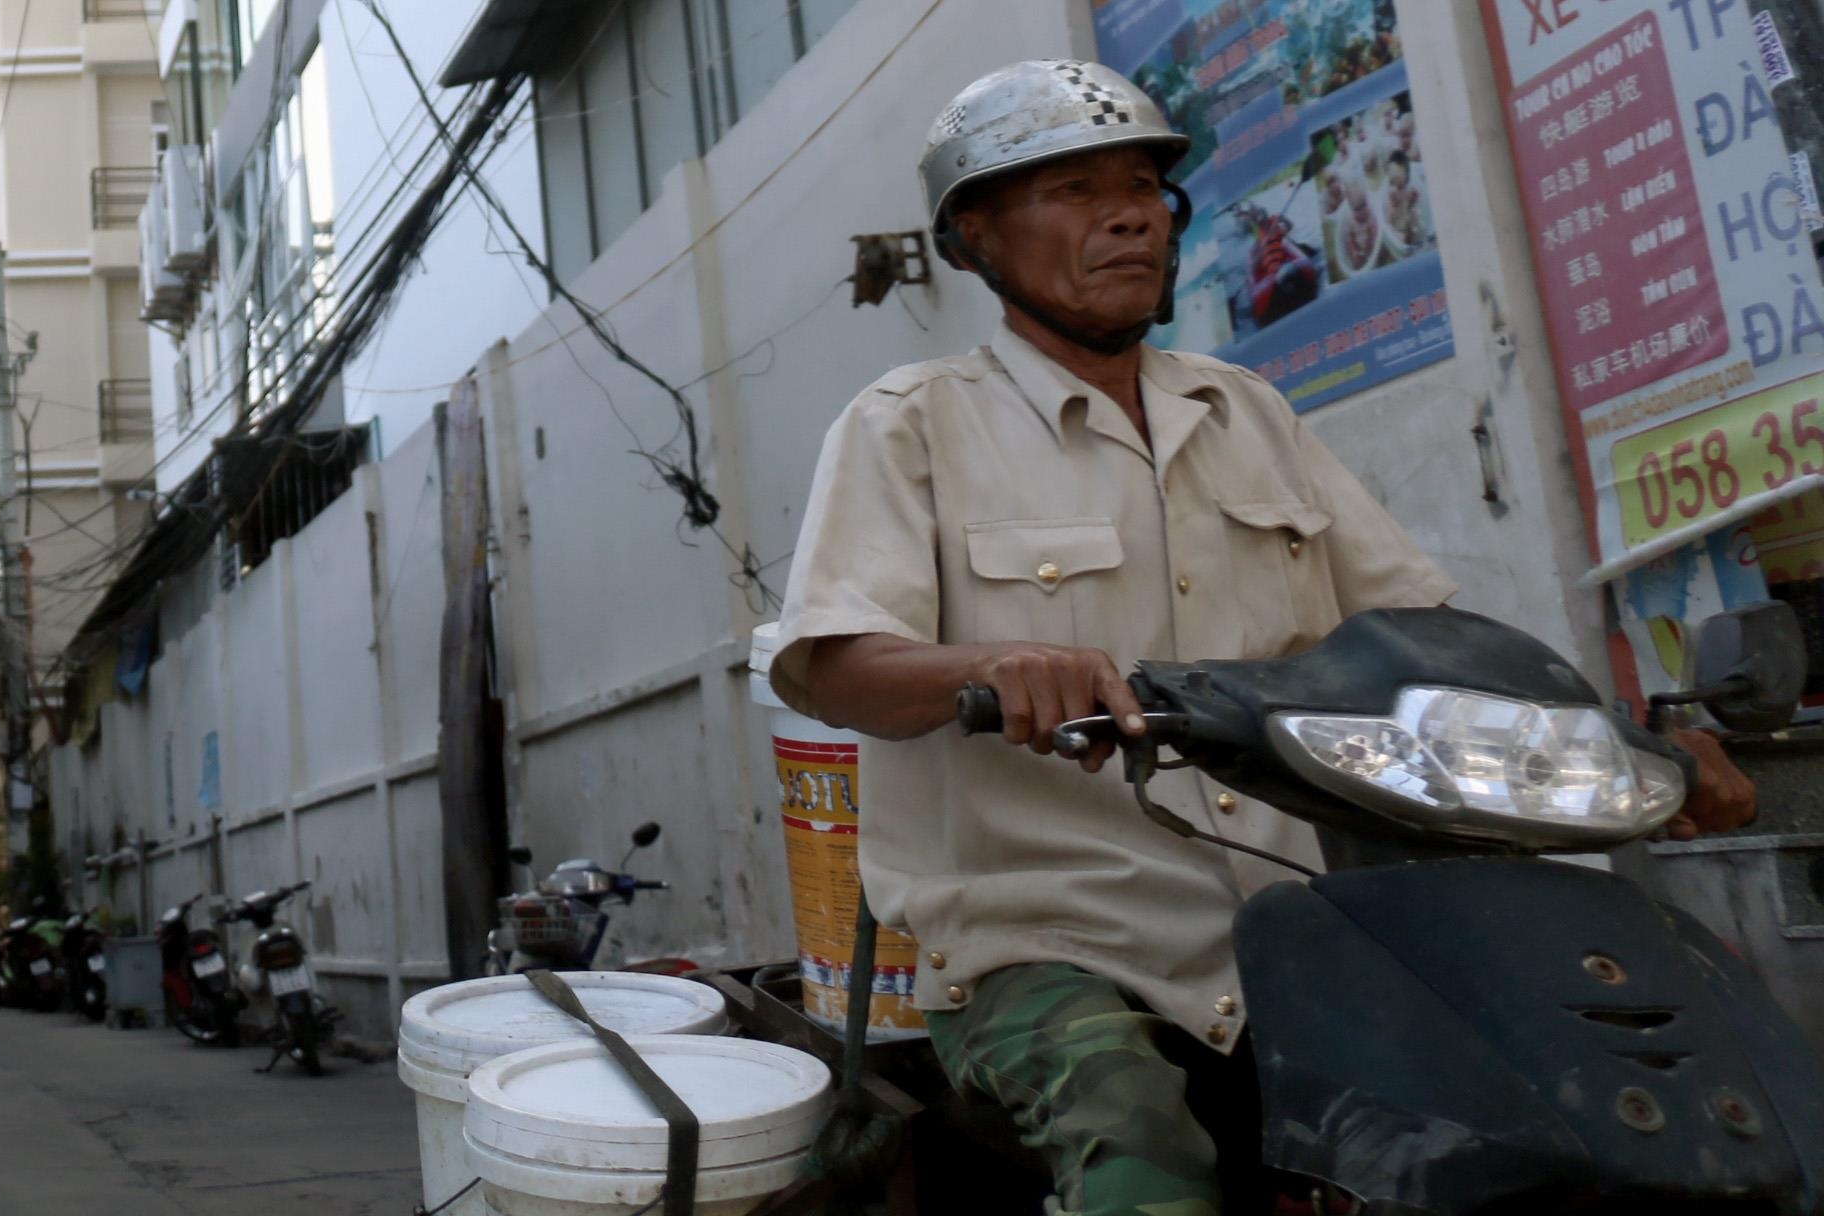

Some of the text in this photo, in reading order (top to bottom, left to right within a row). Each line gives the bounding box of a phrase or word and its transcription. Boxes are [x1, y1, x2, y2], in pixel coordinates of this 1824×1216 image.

[1718, 170, 1806, 262] HỘ
[1741, 272, 1824, 369] ĐÀ
[1637, 428, 1742, 529] 058
